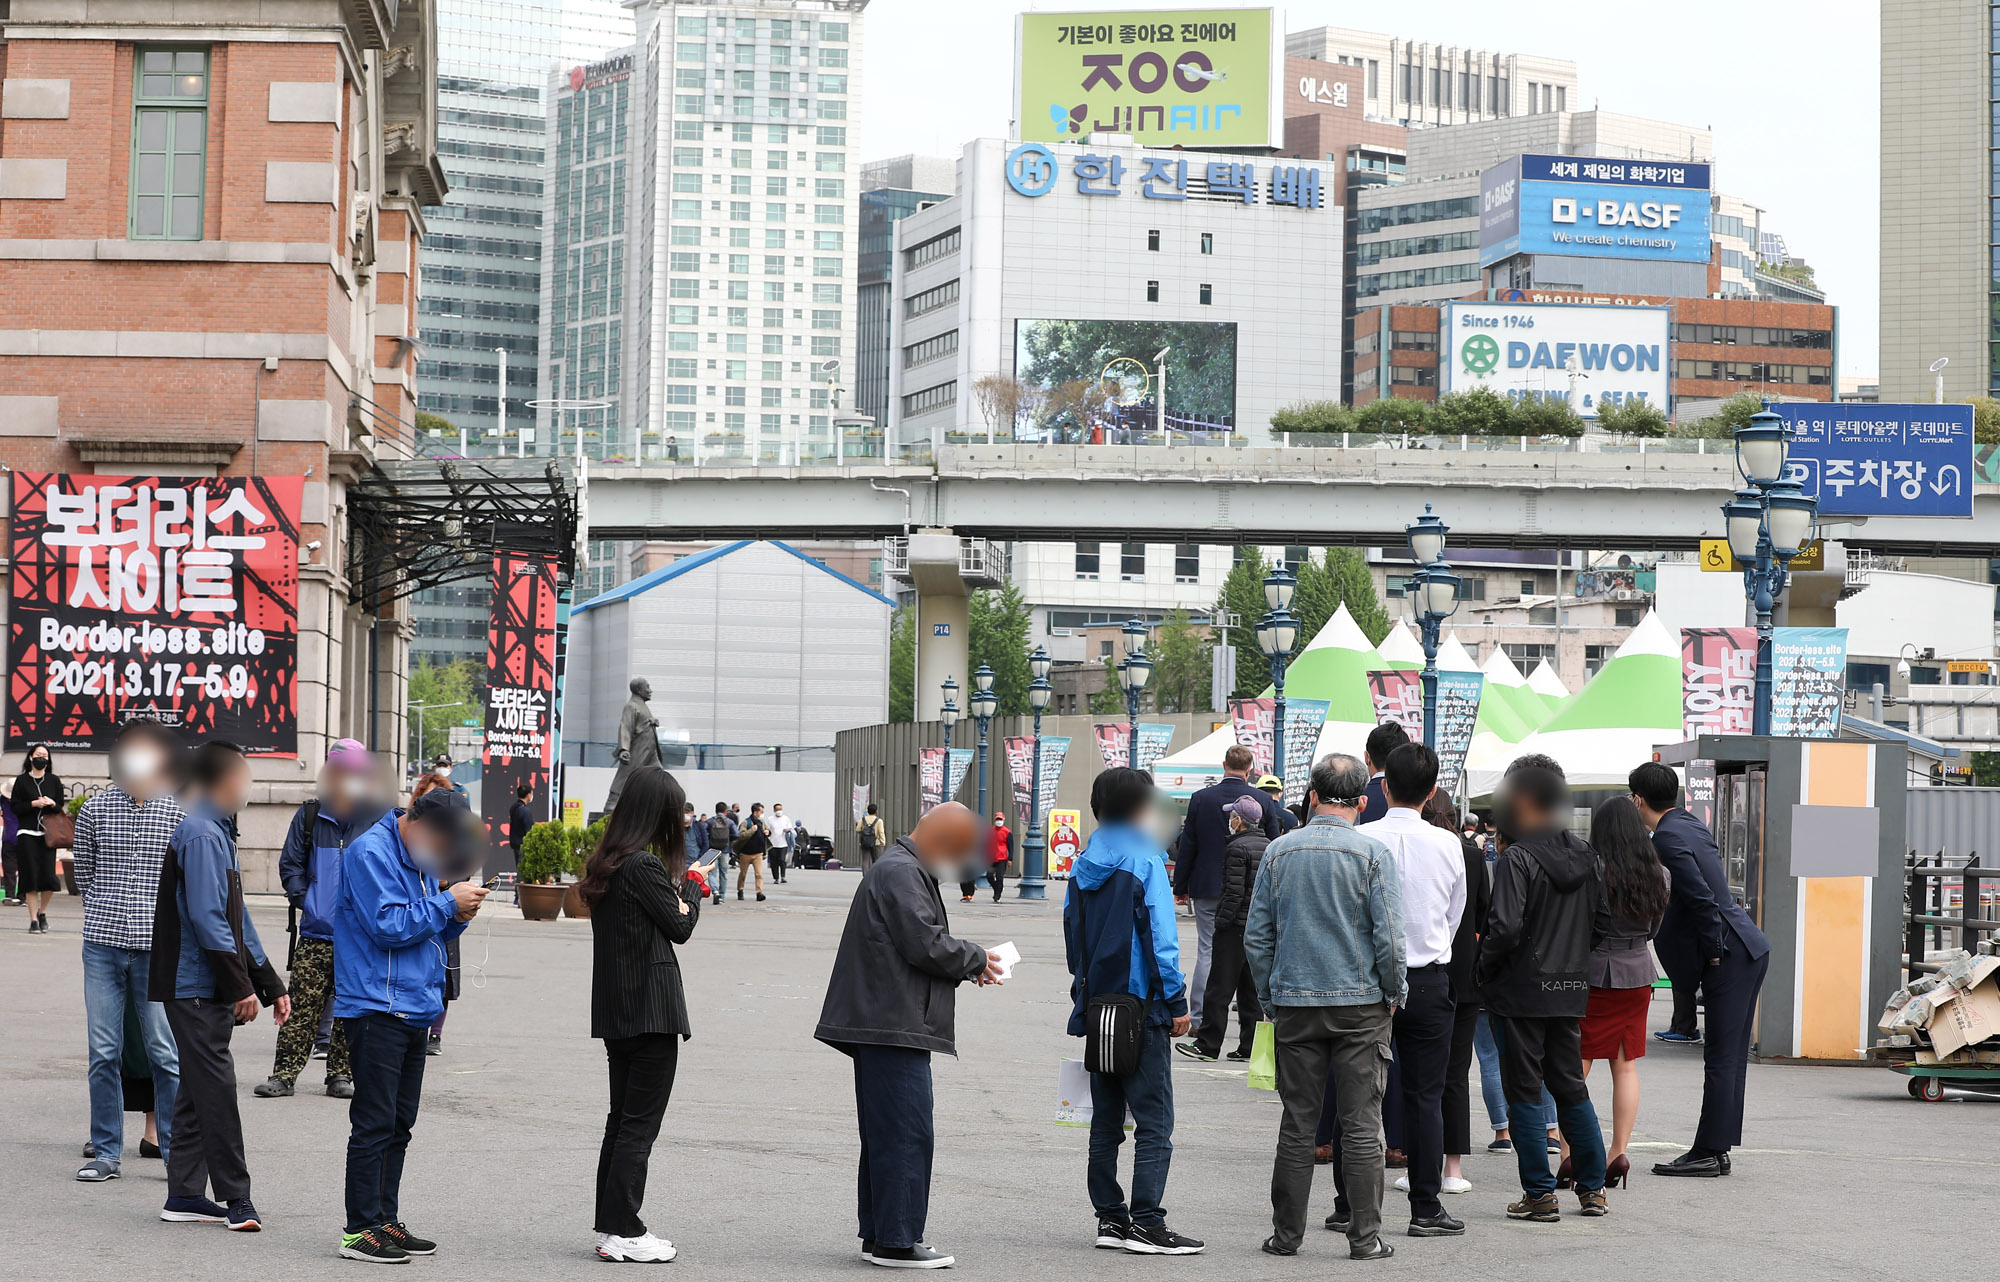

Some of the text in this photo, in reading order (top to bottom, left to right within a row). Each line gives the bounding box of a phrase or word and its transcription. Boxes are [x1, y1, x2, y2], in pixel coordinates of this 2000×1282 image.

[1058, 22, 1236, 45] 기본이 좋아요 진에어
[1299, 77, 1348, 108] 에스원
[1074, 153, 1320, 209] 한진택배
[1550, 162, 1685, 184] 세계 제일의 화학기업
[1494, 179, 1515, 208] BASF
[1597, 199, 1682, 229] BASF
[1553, 231, 1677, 251] We create chemistry
[1462, 314, 1534, 329] Since 1946
[1508, 341, 1660, 371] DAEWON
[1584, 394, 1593, 408] &
[1834, 420, 1899, 436] 롯데아울렛
[1909, 421, 1964, 437] 롯데마트
[1825, 459, 1927, 501] 주차장
[42, 484, 266, 551] 보더리스
[69, 546, 238, 613] 사이트
[40, 617, 265, 656] Border-less.site
[934, 625, 949, 635] P14
[1775, 643, 1842, 655] Border-less.site
[1773, 669, 1841, 681] Border-less.site
[489, 687, 547, 712] 보더리스
[495, 708, 539, 731] 사이트
[487, 730, 545, 745] Border-less.site
[1541, 980, 1588, 991] KAPPA
